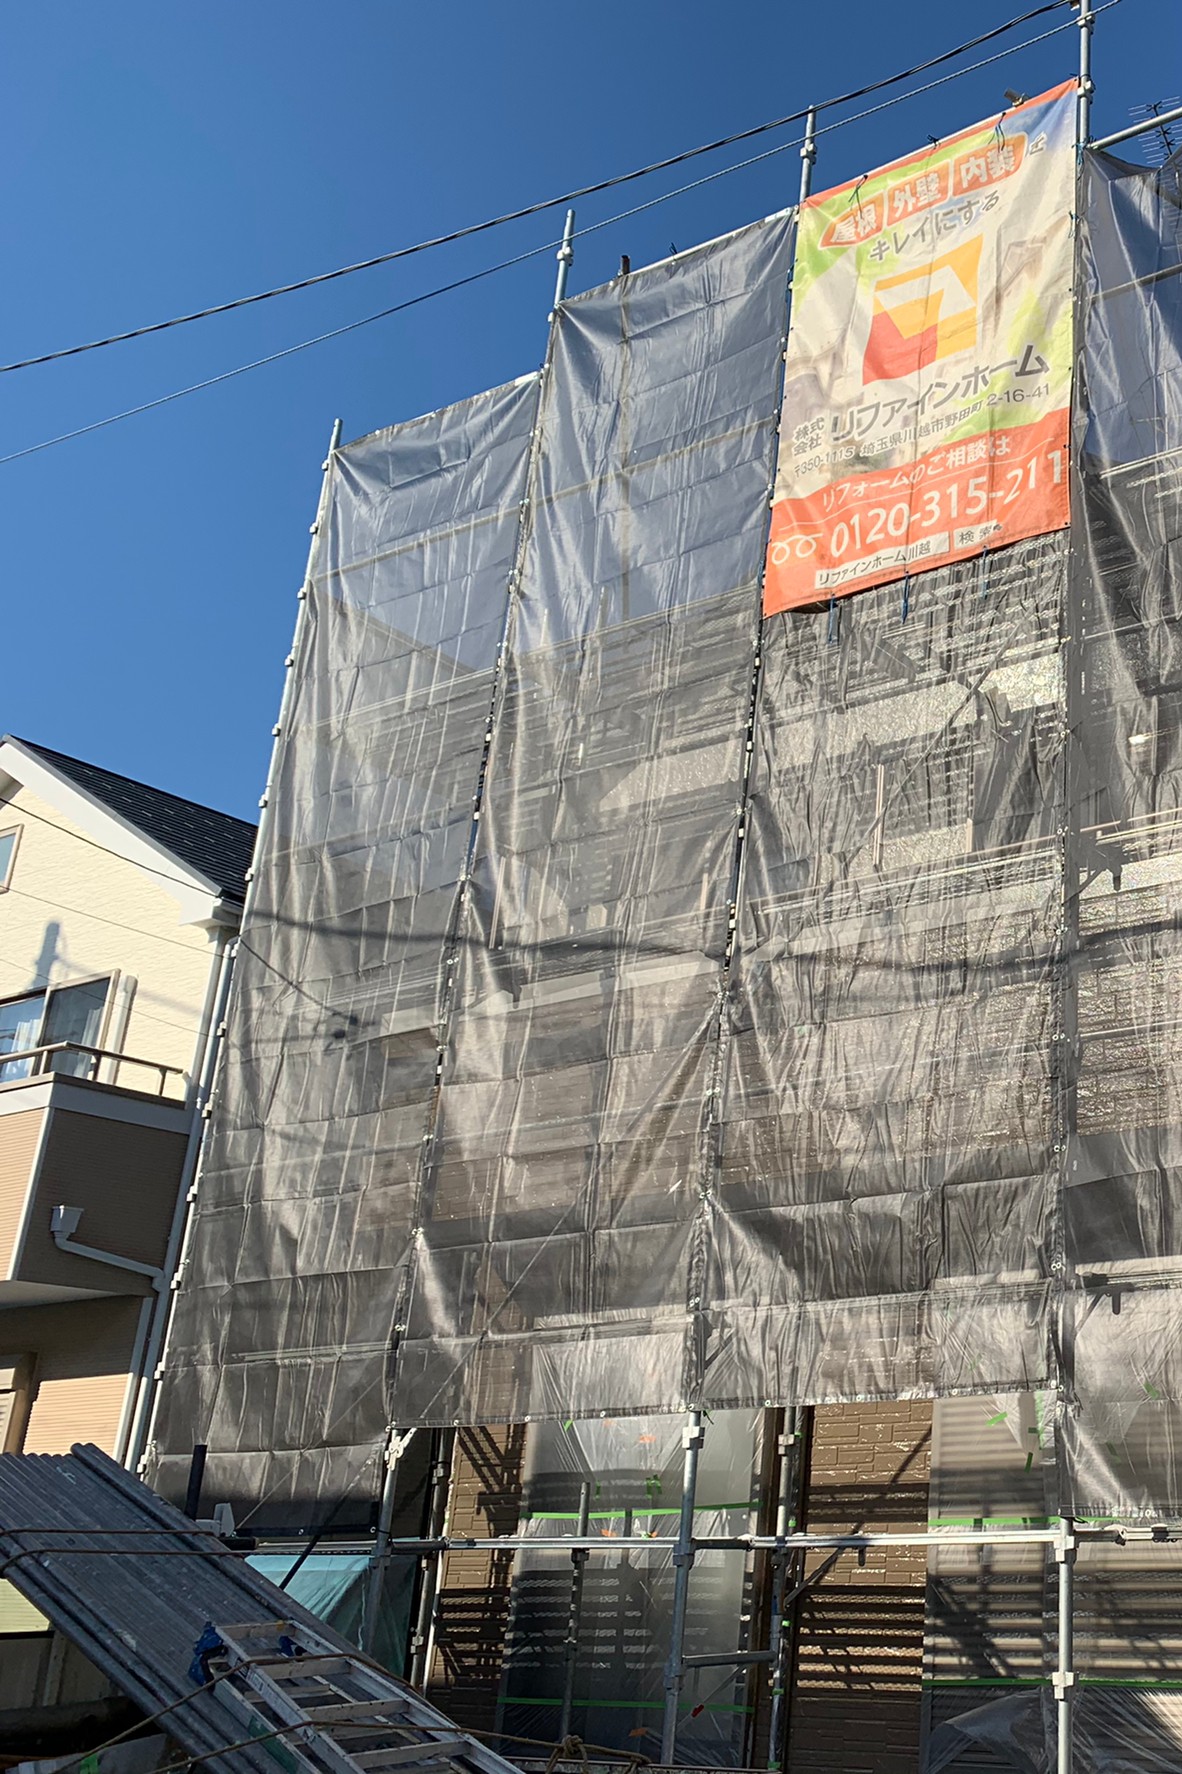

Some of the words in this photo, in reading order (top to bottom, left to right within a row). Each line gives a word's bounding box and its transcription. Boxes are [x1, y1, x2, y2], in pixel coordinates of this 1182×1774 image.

[830, 203, 878, 243] 屋根
[893, 170, 942, 218] 外壁
[959, 145, 1016, 189] 内装
[869, 189, 999, 261] キレイにする
[794, 416, 825, 442] 株式
[831, 344, 1051, 441] リファインホーム
[793, 435, 822, 456] 会社
[822, 435, 1011, 512] リフォームのご相談は
[830, 450, 1062, 558] 0120-315-211
